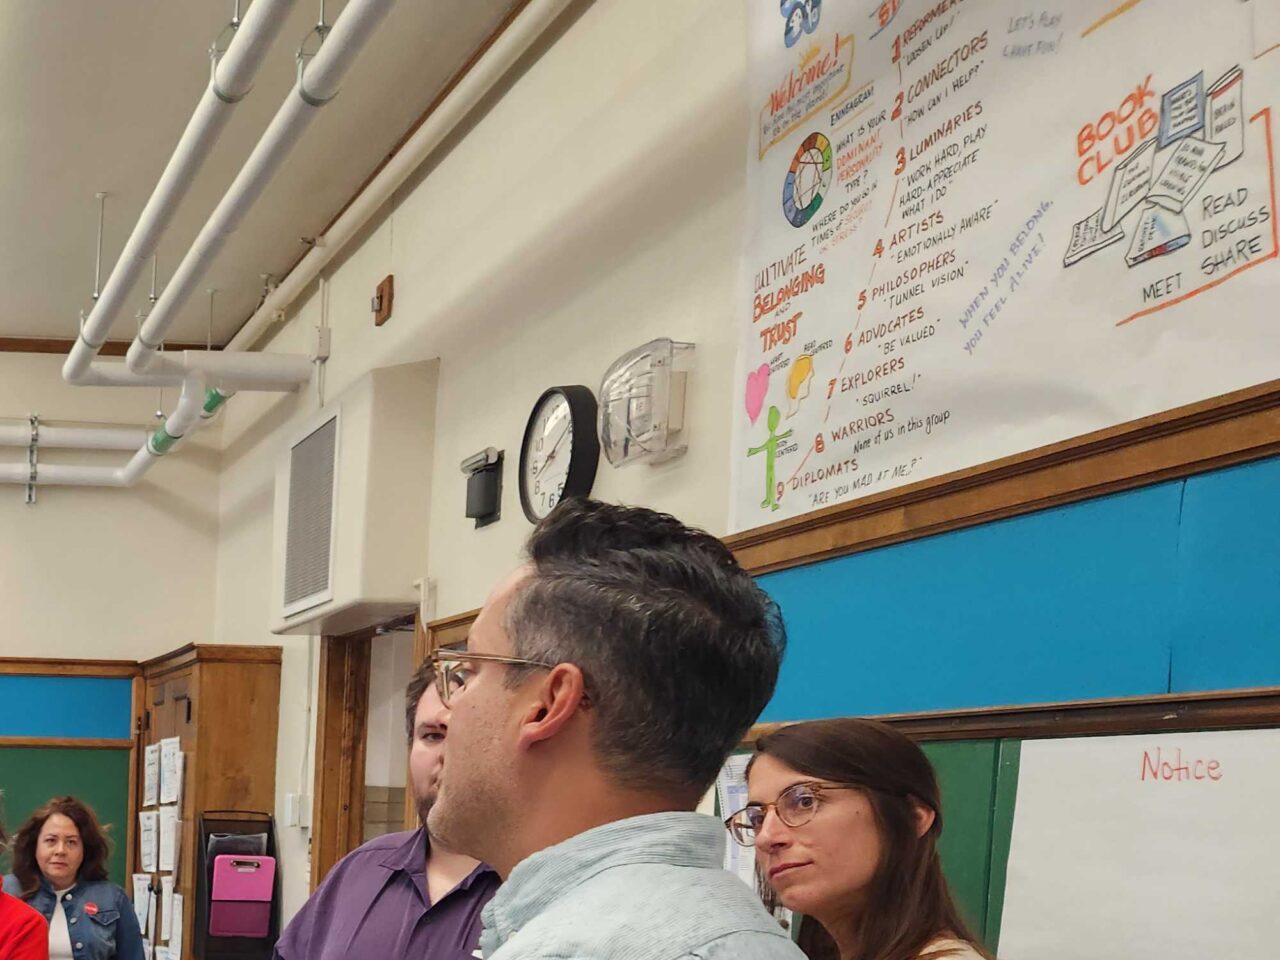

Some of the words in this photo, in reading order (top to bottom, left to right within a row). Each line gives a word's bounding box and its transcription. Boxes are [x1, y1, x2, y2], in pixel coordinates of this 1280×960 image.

[892, 34, 901, 64] 1
[892, 91, 904, 121] 2
[907, 30, 988, 104] CONNECTORS
[963, 123, 988, 148] PLAY
[1078, 72, 1155, 158] BOOK
[894, 146, 906, 176] 3
[910, 100, 983, 161] LUMINARIES
[1078, 108, 1158, 185] CLUB
[902, 198, 925, 219] WHAT
[1202, 188, 1248, 221] READ
[873, 239, 885, 258] 4
[889, 210, 944, 250] ARTISTS
[1202, 205, 1270, 249] DISCUSS
[754, 243, 807, 294] CULTIVATE
[1201, 235, 1262, 275] SHARE
[753, 263, 826, 323] BELONGING
[857, 289, 867, 310] 5
[872, 249, 956, 301] PHILOSOPHERS
[959, 286, 989, 329] WHEN
[990, 257, 1010, 288] YOU
[1143, 272, 1182, 303] MEET
[760, 312, 803, 353] TRUST
[844, 332, 853, 354] 6
[858, 307, 924, 346] ADVOCATES
[964, 329, 982, 356] YOU
[982, 296, 1007, 327] FEEL
[827, 378, 837, 399] 7
[841, 357, 905, 392] EXPLORERS
[815, 433, 824, 453] 8
[831, 408, 895, 442] WARRIORS
[907, 417, 923, 432] this
[926, 410, 951, 435] group
[791, 459, 858, 490] DIPLOMATS
[1142, 746, 1223, 781] Notice
